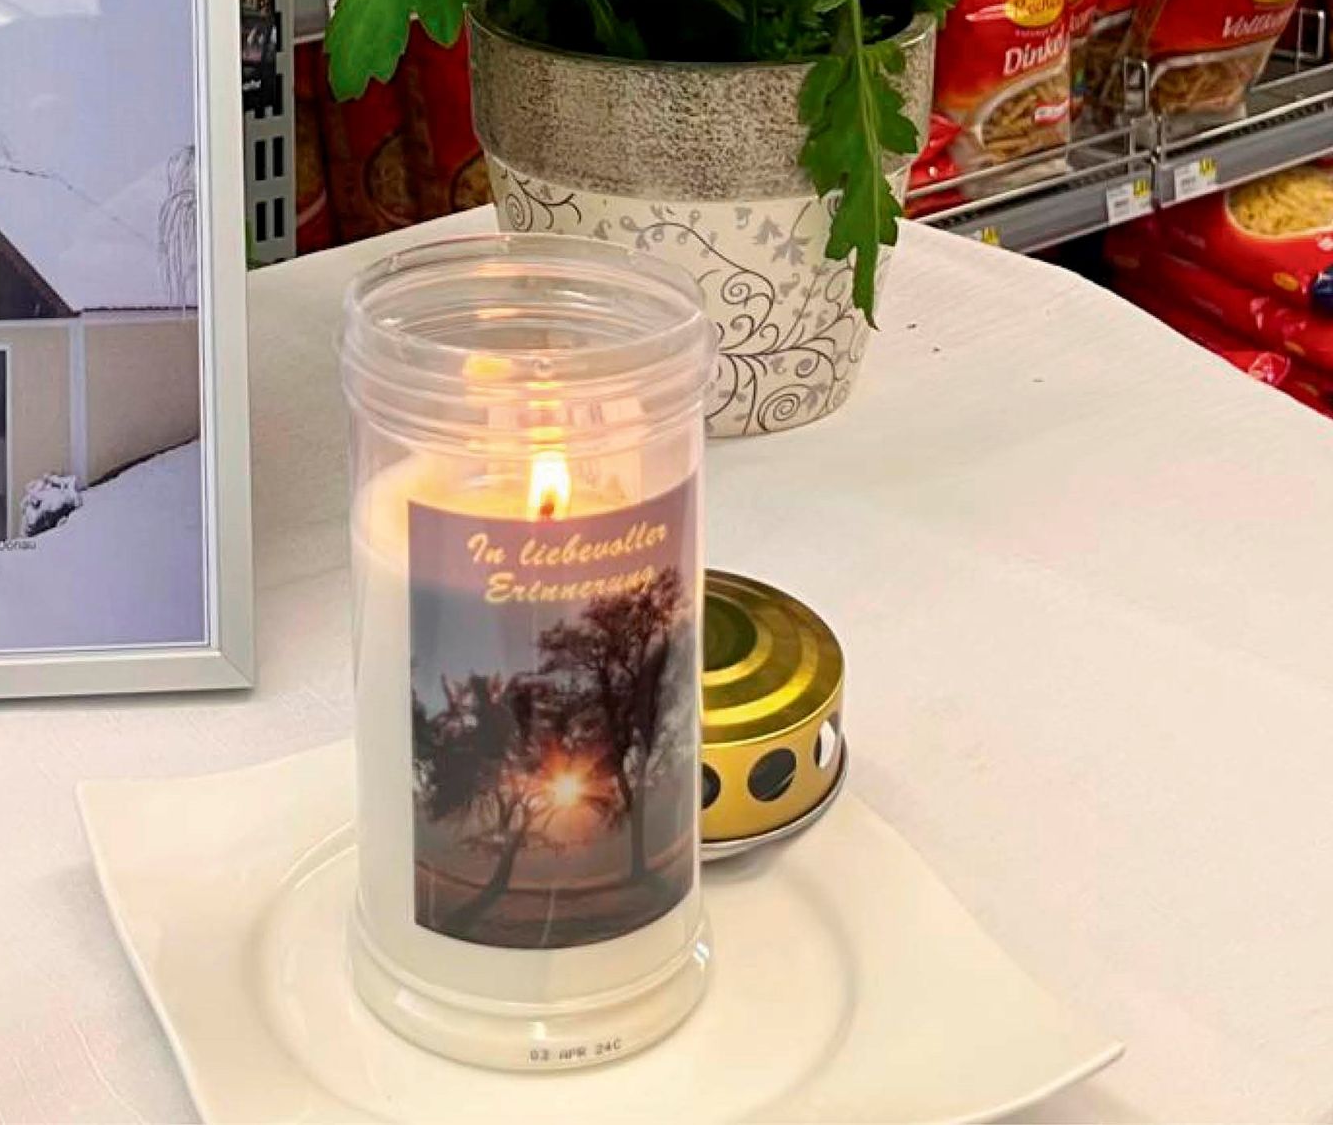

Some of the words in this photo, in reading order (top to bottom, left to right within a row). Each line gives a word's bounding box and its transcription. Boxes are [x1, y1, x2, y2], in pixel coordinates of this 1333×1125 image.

[468, 532, 506, 565] In
[519, 522, 667, 567] liebevoller
[486, 565, 656, 603] Erinnerung
